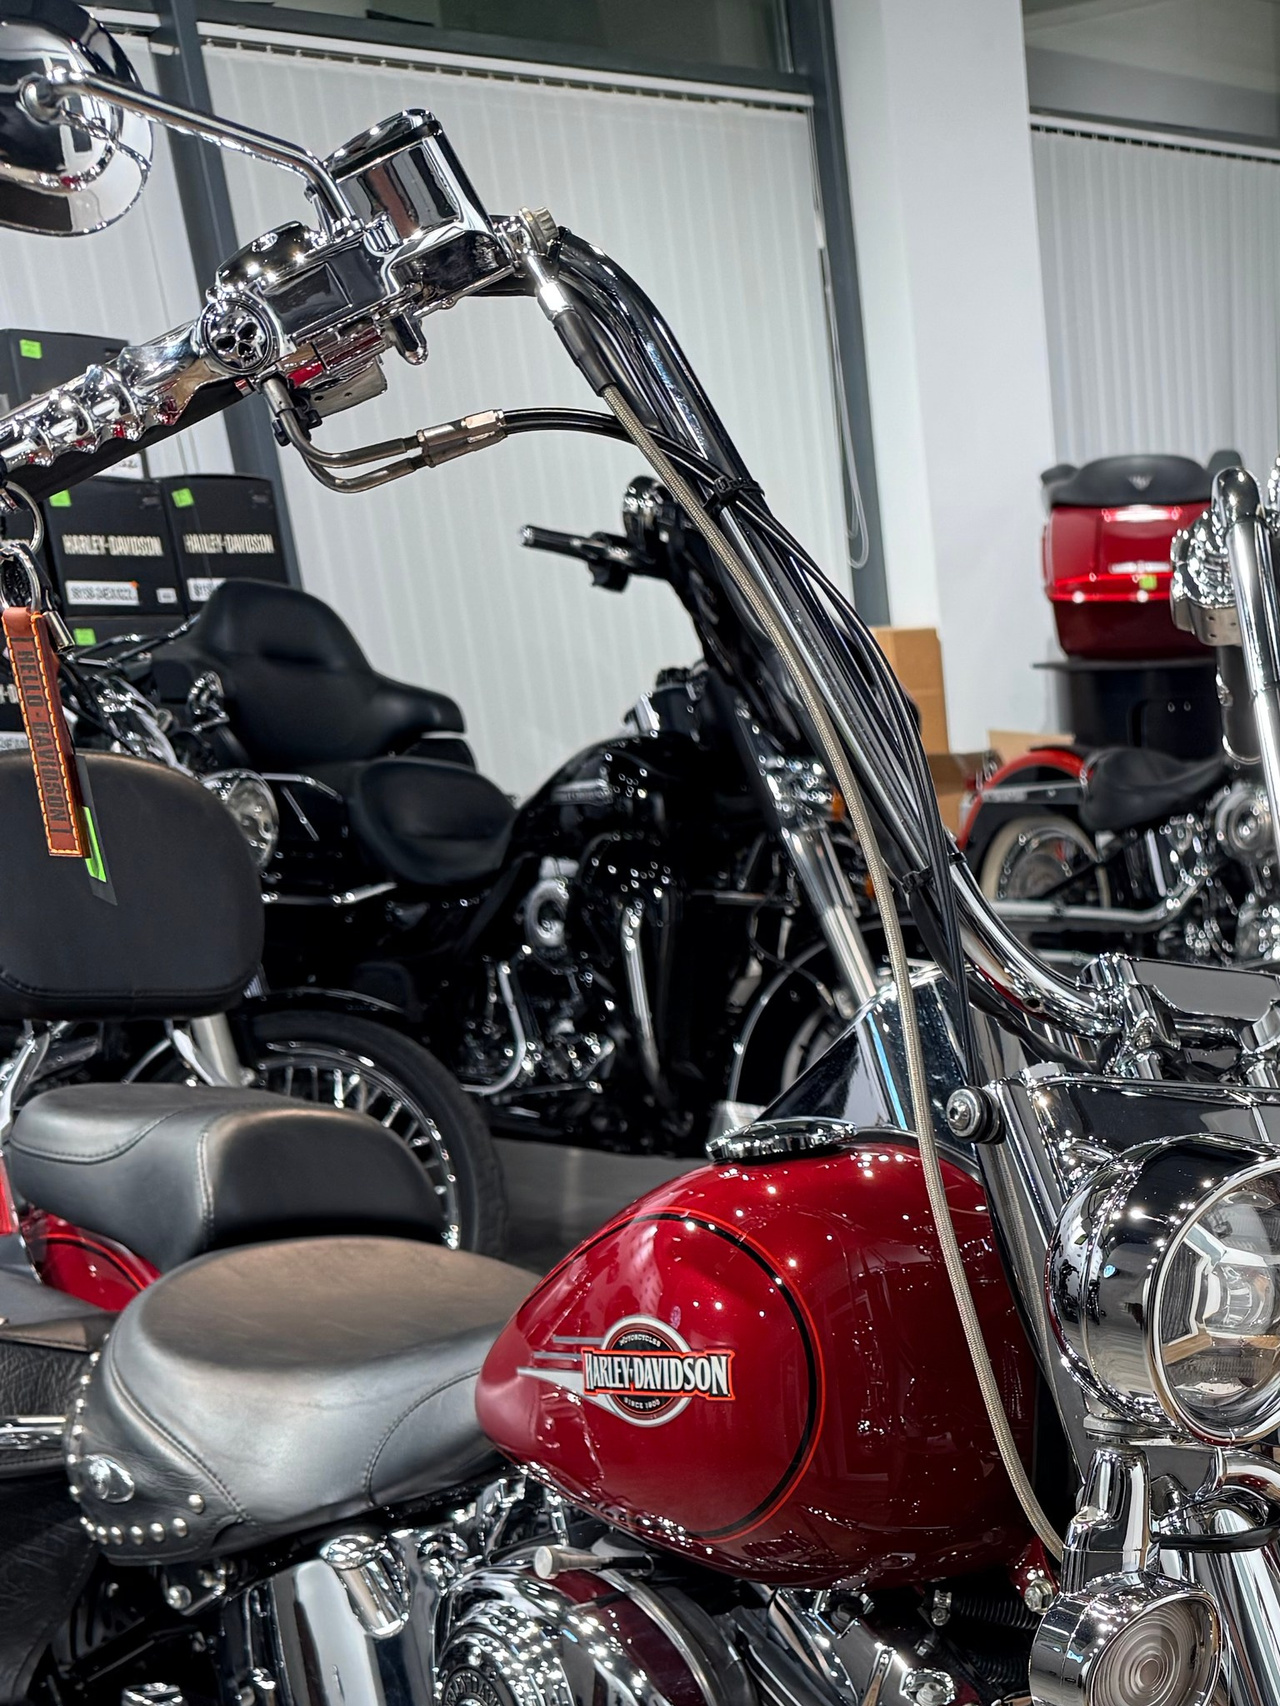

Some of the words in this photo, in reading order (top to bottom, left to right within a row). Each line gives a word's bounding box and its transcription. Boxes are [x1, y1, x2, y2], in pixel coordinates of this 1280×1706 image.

[17, 649, 42, 708] HELLO
[32, 720, 68, 823] DAVIDSON
[584, 1352, 730, 1396] HARLEY-DAVIDSON
